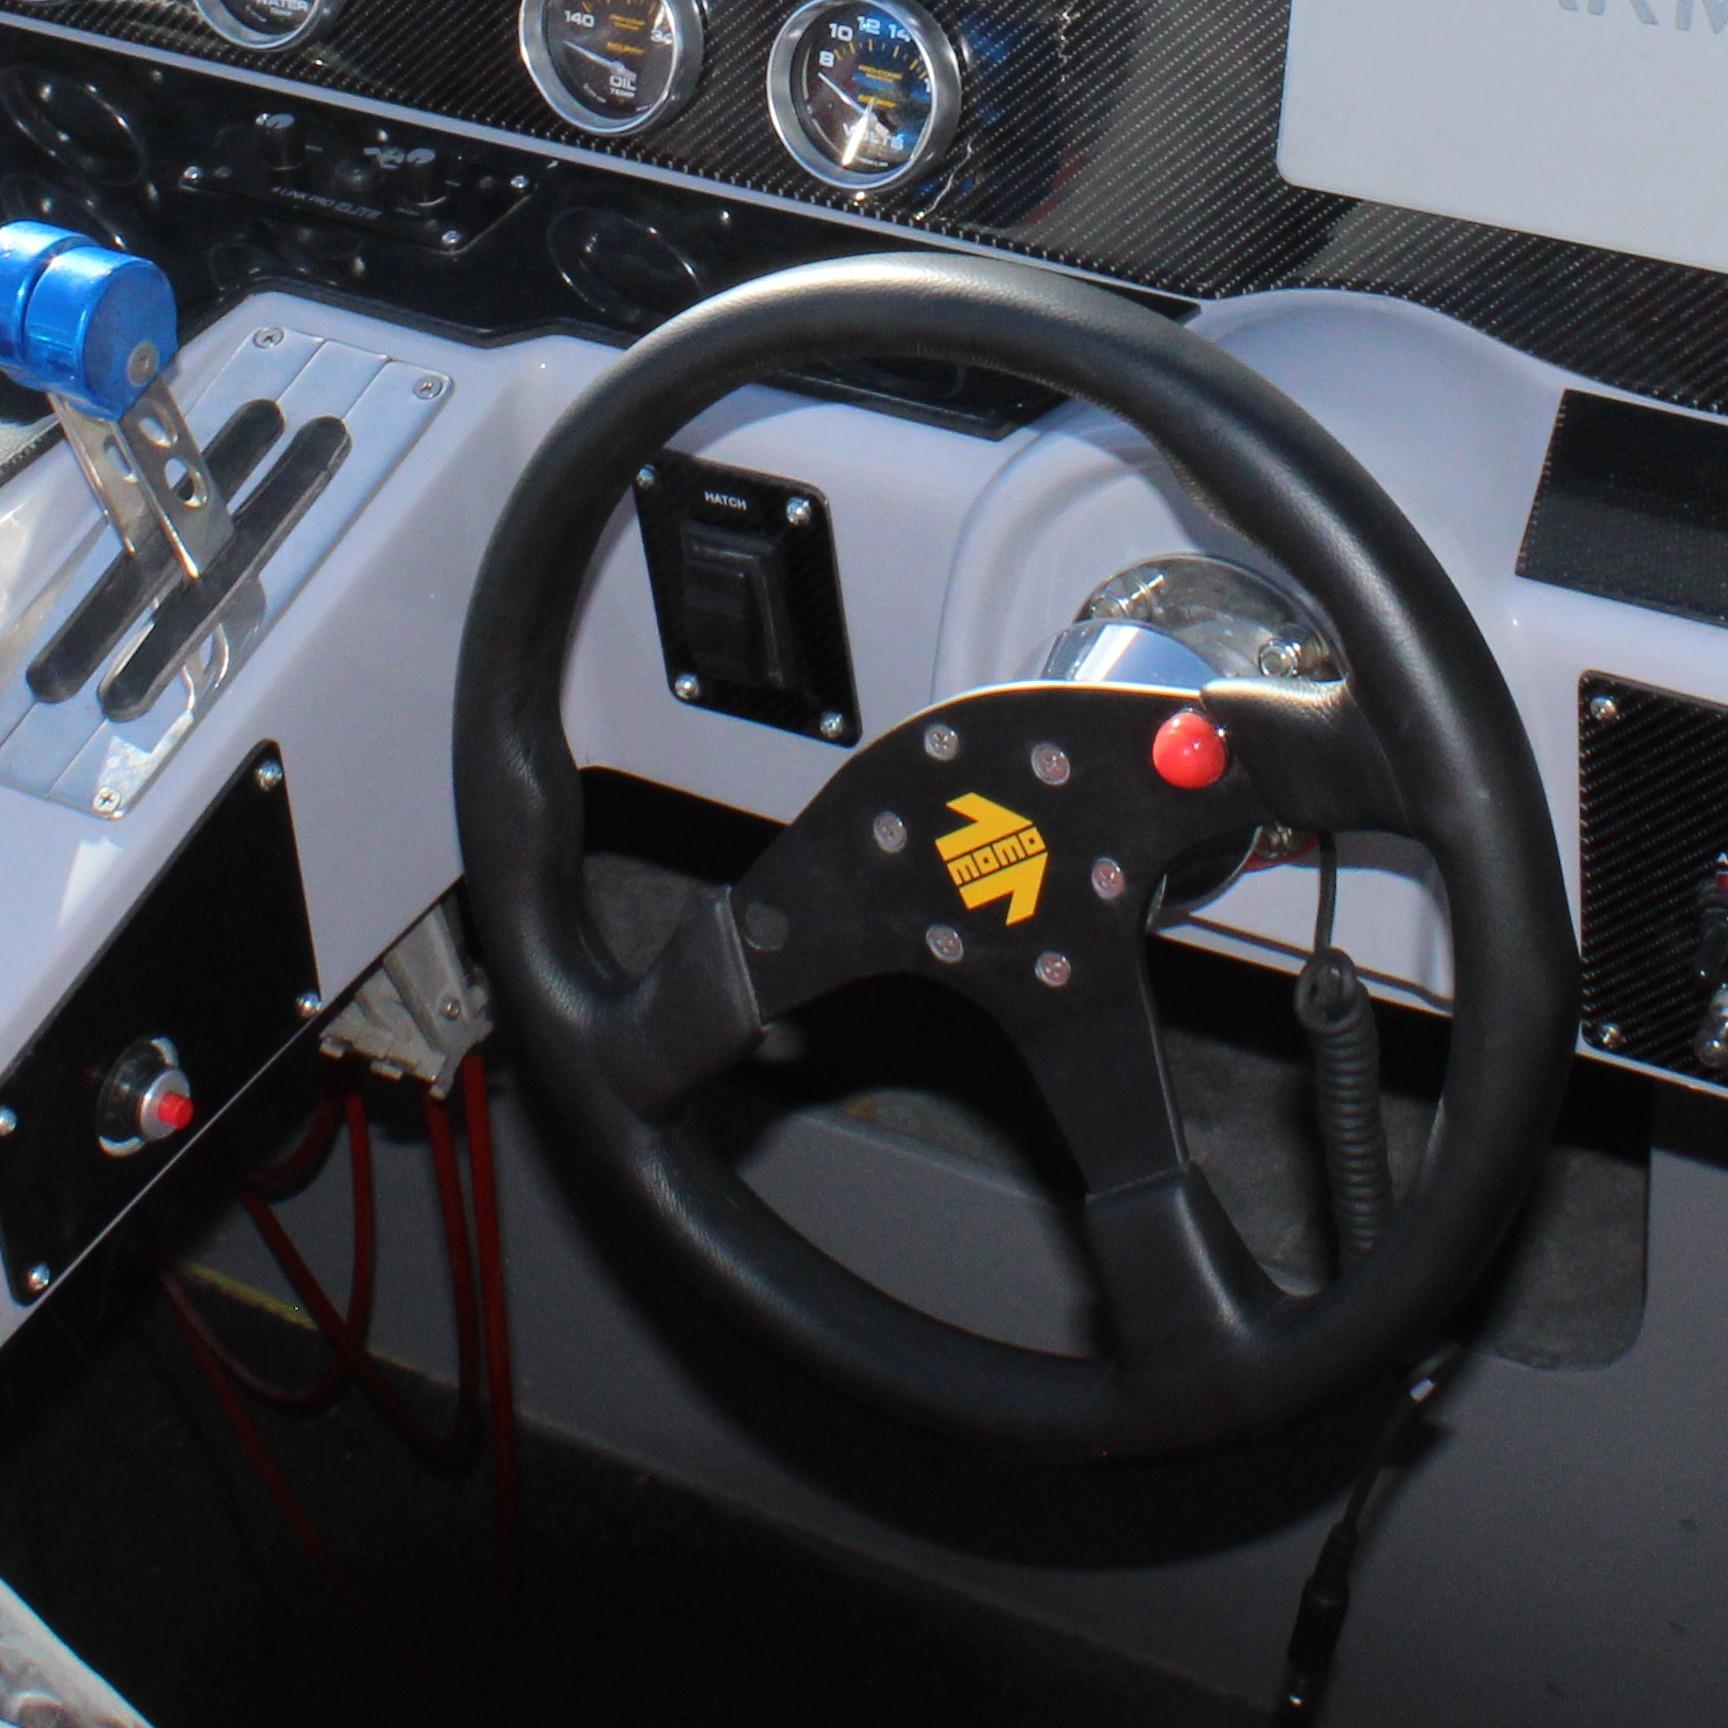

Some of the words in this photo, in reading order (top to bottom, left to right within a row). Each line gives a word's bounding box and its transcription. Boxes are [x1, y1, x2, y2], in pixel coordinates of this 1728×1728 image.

[563, 10, 595, 28] 140
[857, 15, 881, 35] 12
[829, 22, 853, 42] 10
[819, 50, 835, 68] 8
[610, 74, 637, 91] OIL
[704, 491, 748, 511] HATCH
